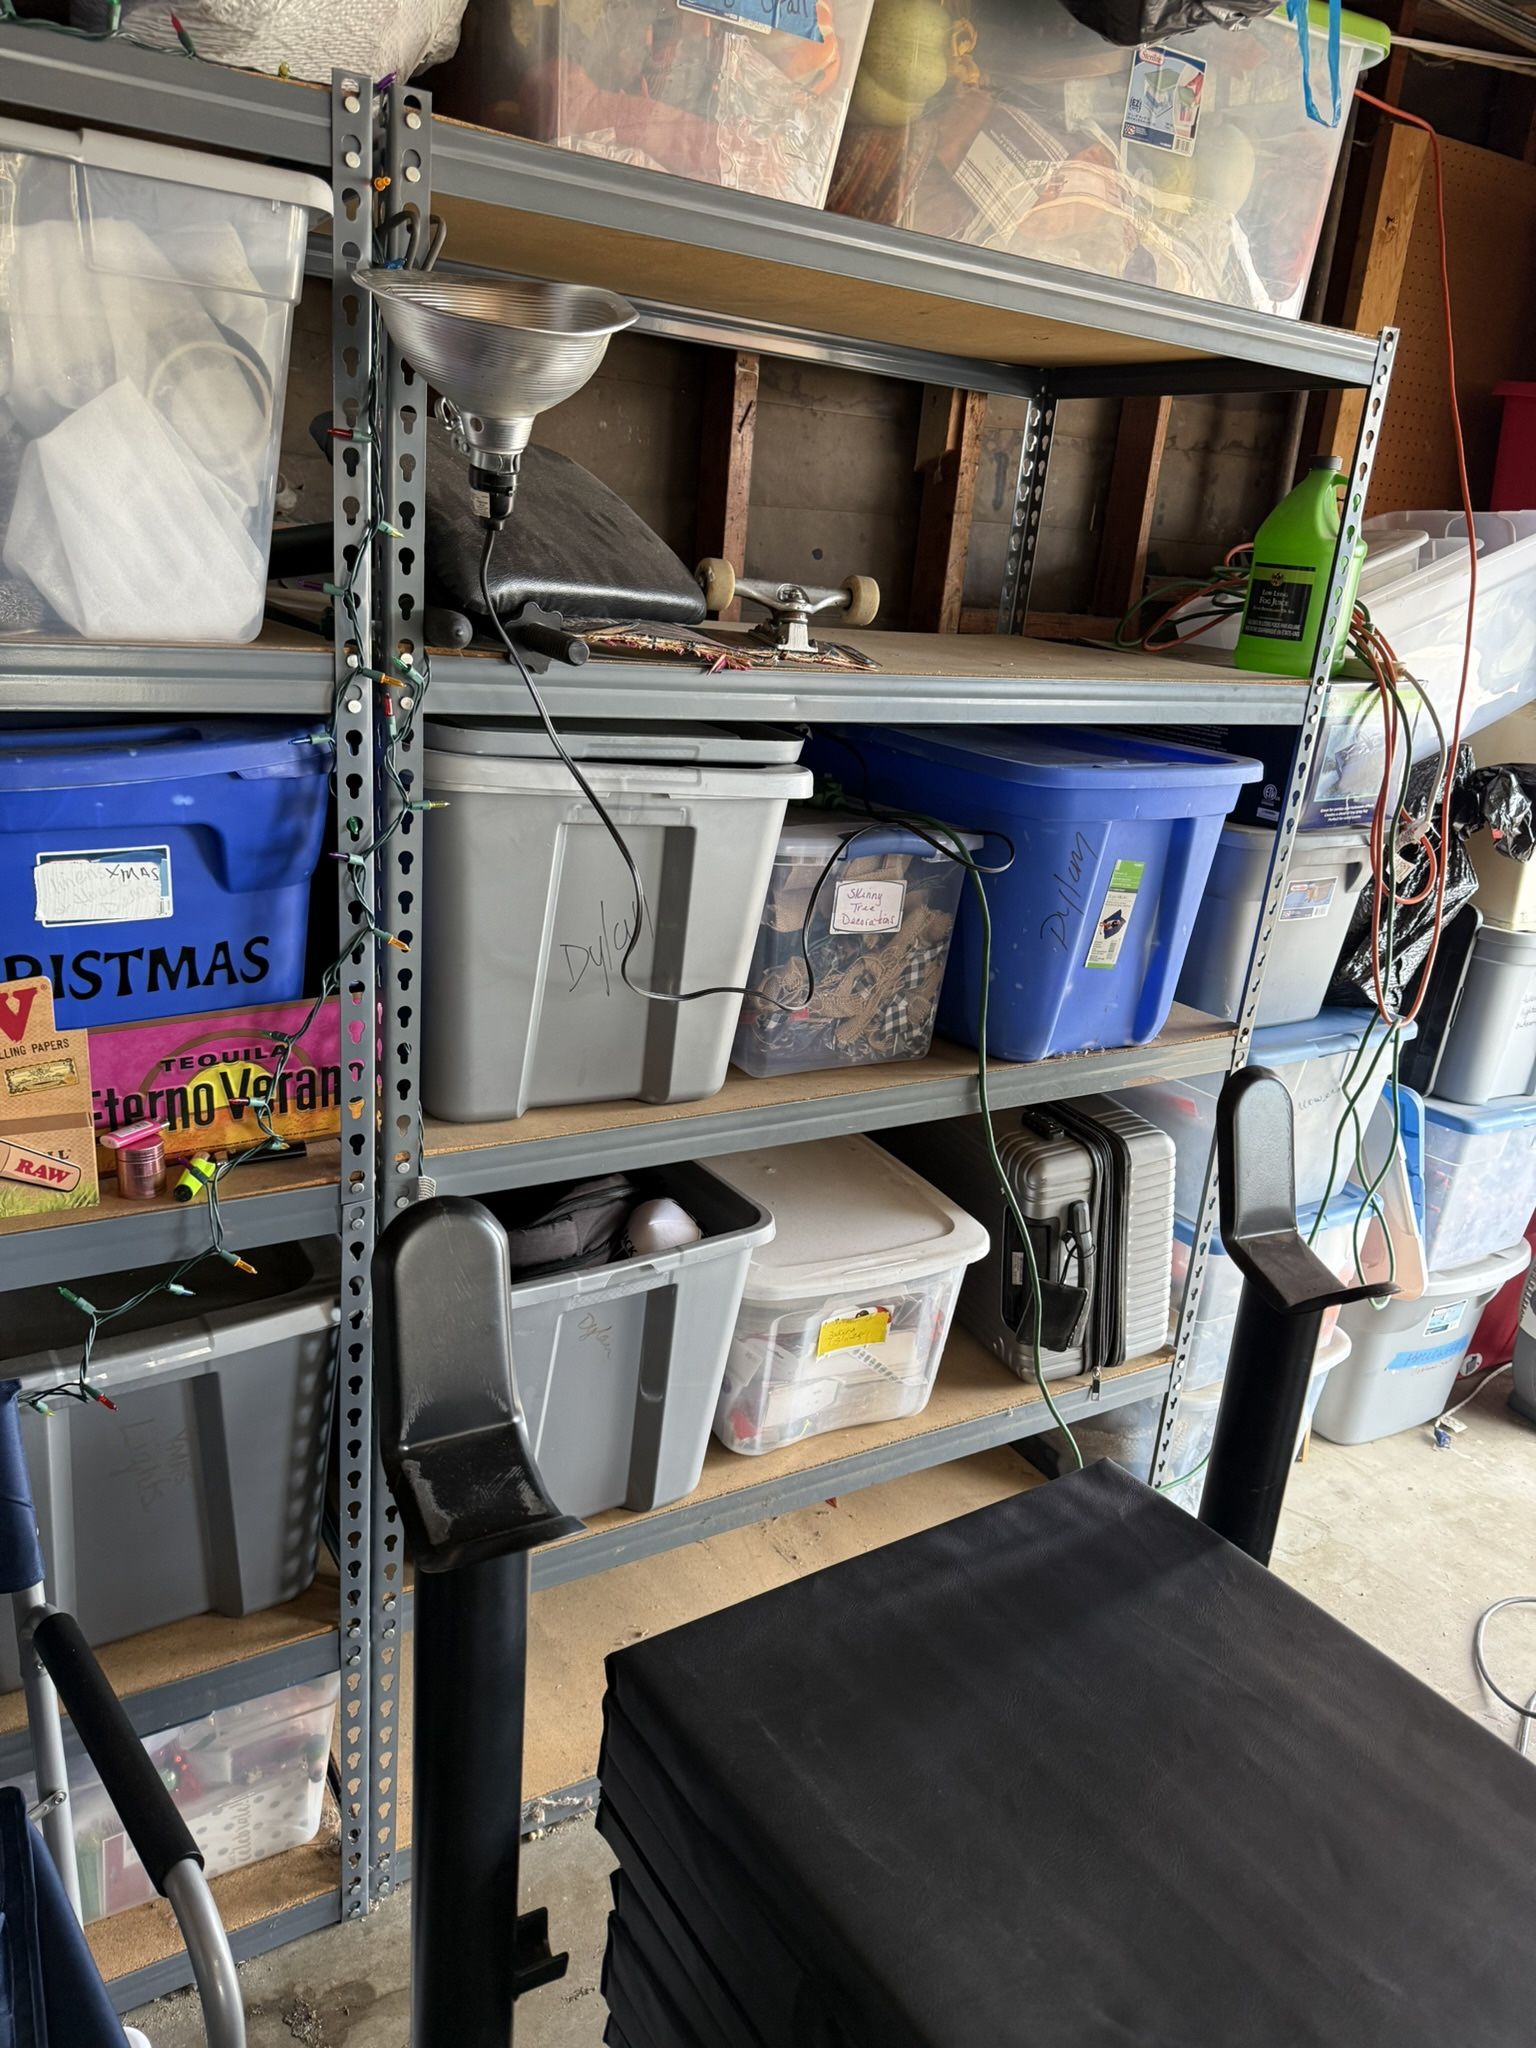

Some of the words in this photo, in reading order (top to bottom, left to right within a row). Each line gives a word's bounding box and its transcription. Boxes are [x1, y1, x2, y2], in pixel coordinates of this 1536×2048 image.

[31, 1038, 70, 1053] PAPERS
[160, 1043, 291, 1072] TEQUILA
[15, 1158, 71, 1183] RAW
